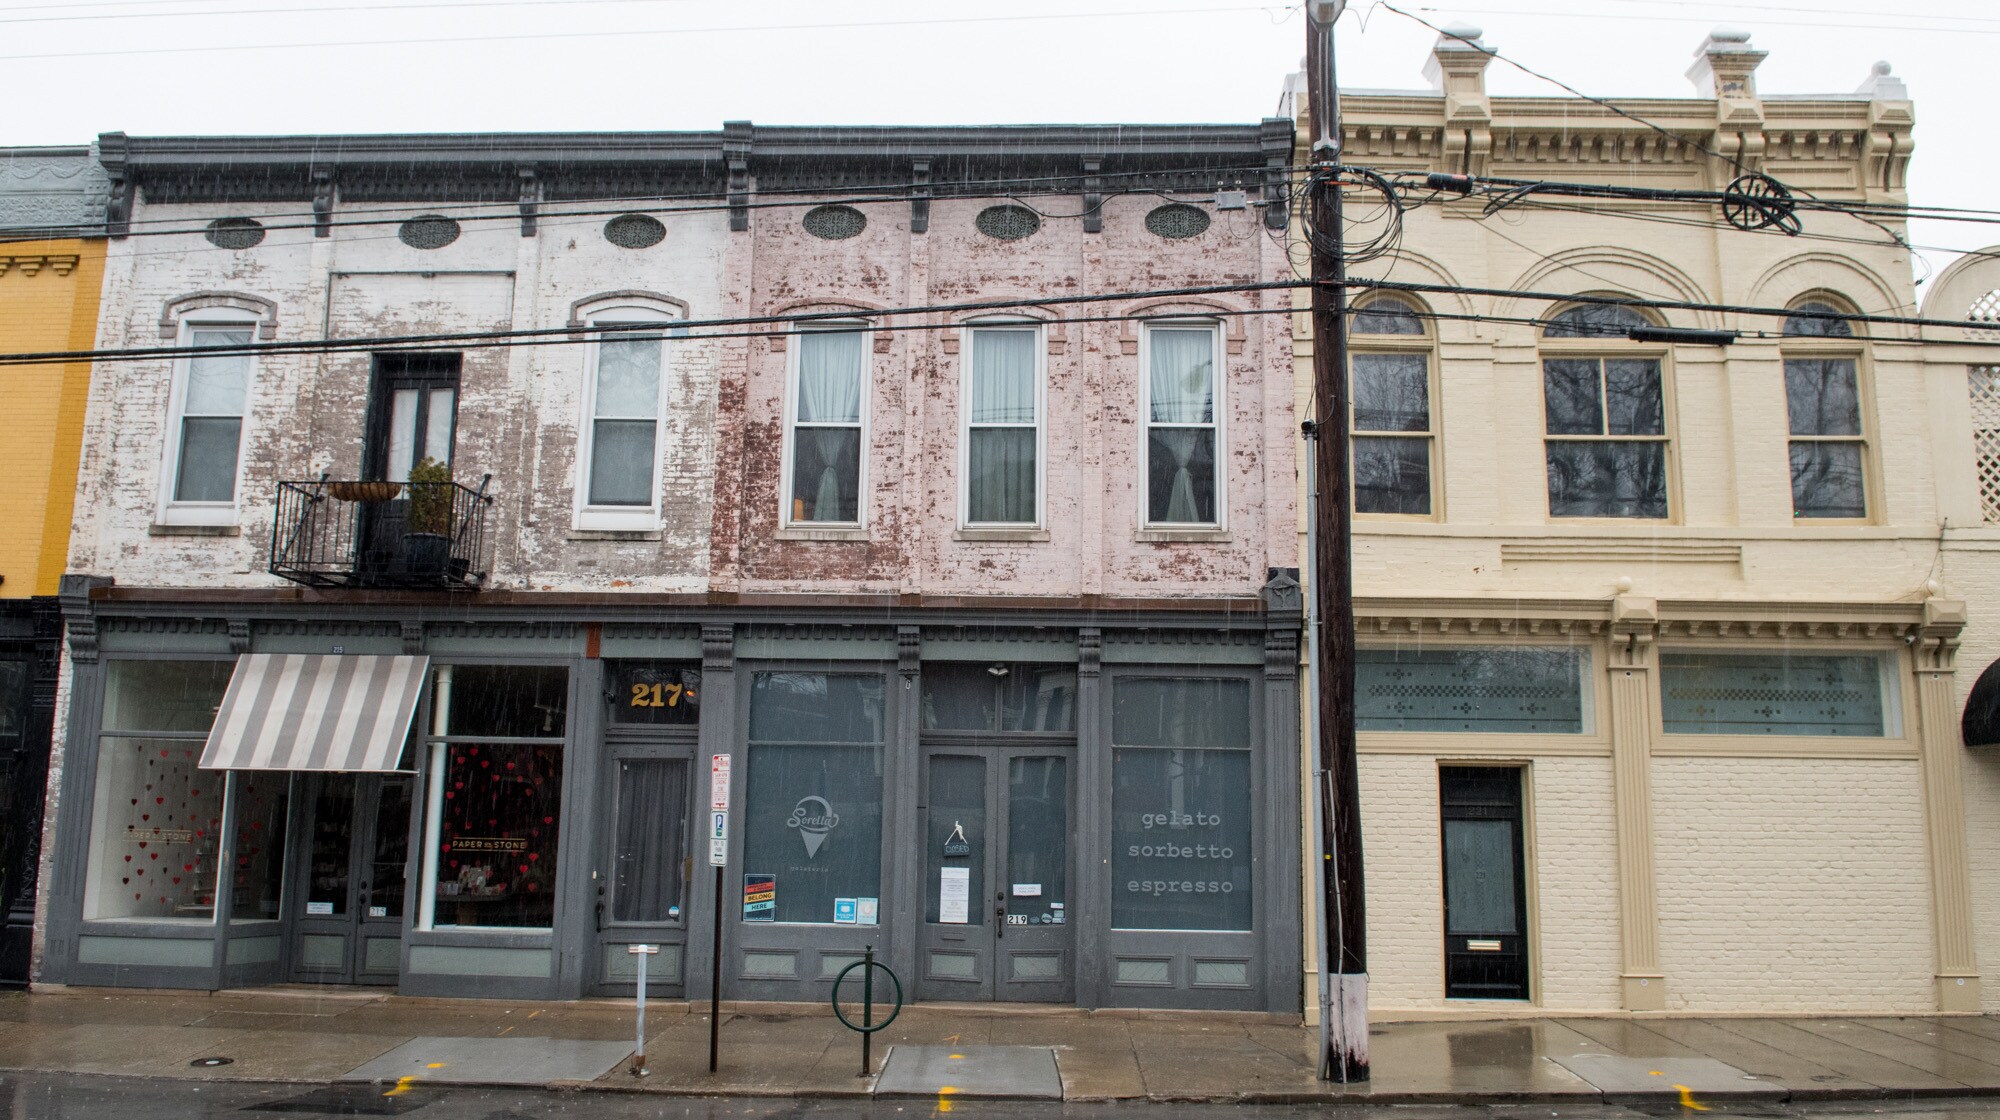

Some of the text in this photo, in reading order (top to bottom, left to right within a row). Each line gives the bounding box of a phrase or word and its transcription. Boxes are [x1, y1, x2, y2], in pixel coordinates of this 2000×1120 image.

[631, 683, 683, 707] 217
[787, 807, 840, 828] Sorella
[1142, 810, 1220, 829] gelato
[452, 840, 483, 848] PAPER
[494, 841, 526, 849] STONE
[1128, 842, 1233, 859] sorbetto
[747, 892, 772, 902] BELONG
[1127, 880, 1233, 897] espresso
[371, 907, 385, 916] 215
[1008, 915, 1027, 924] 219
